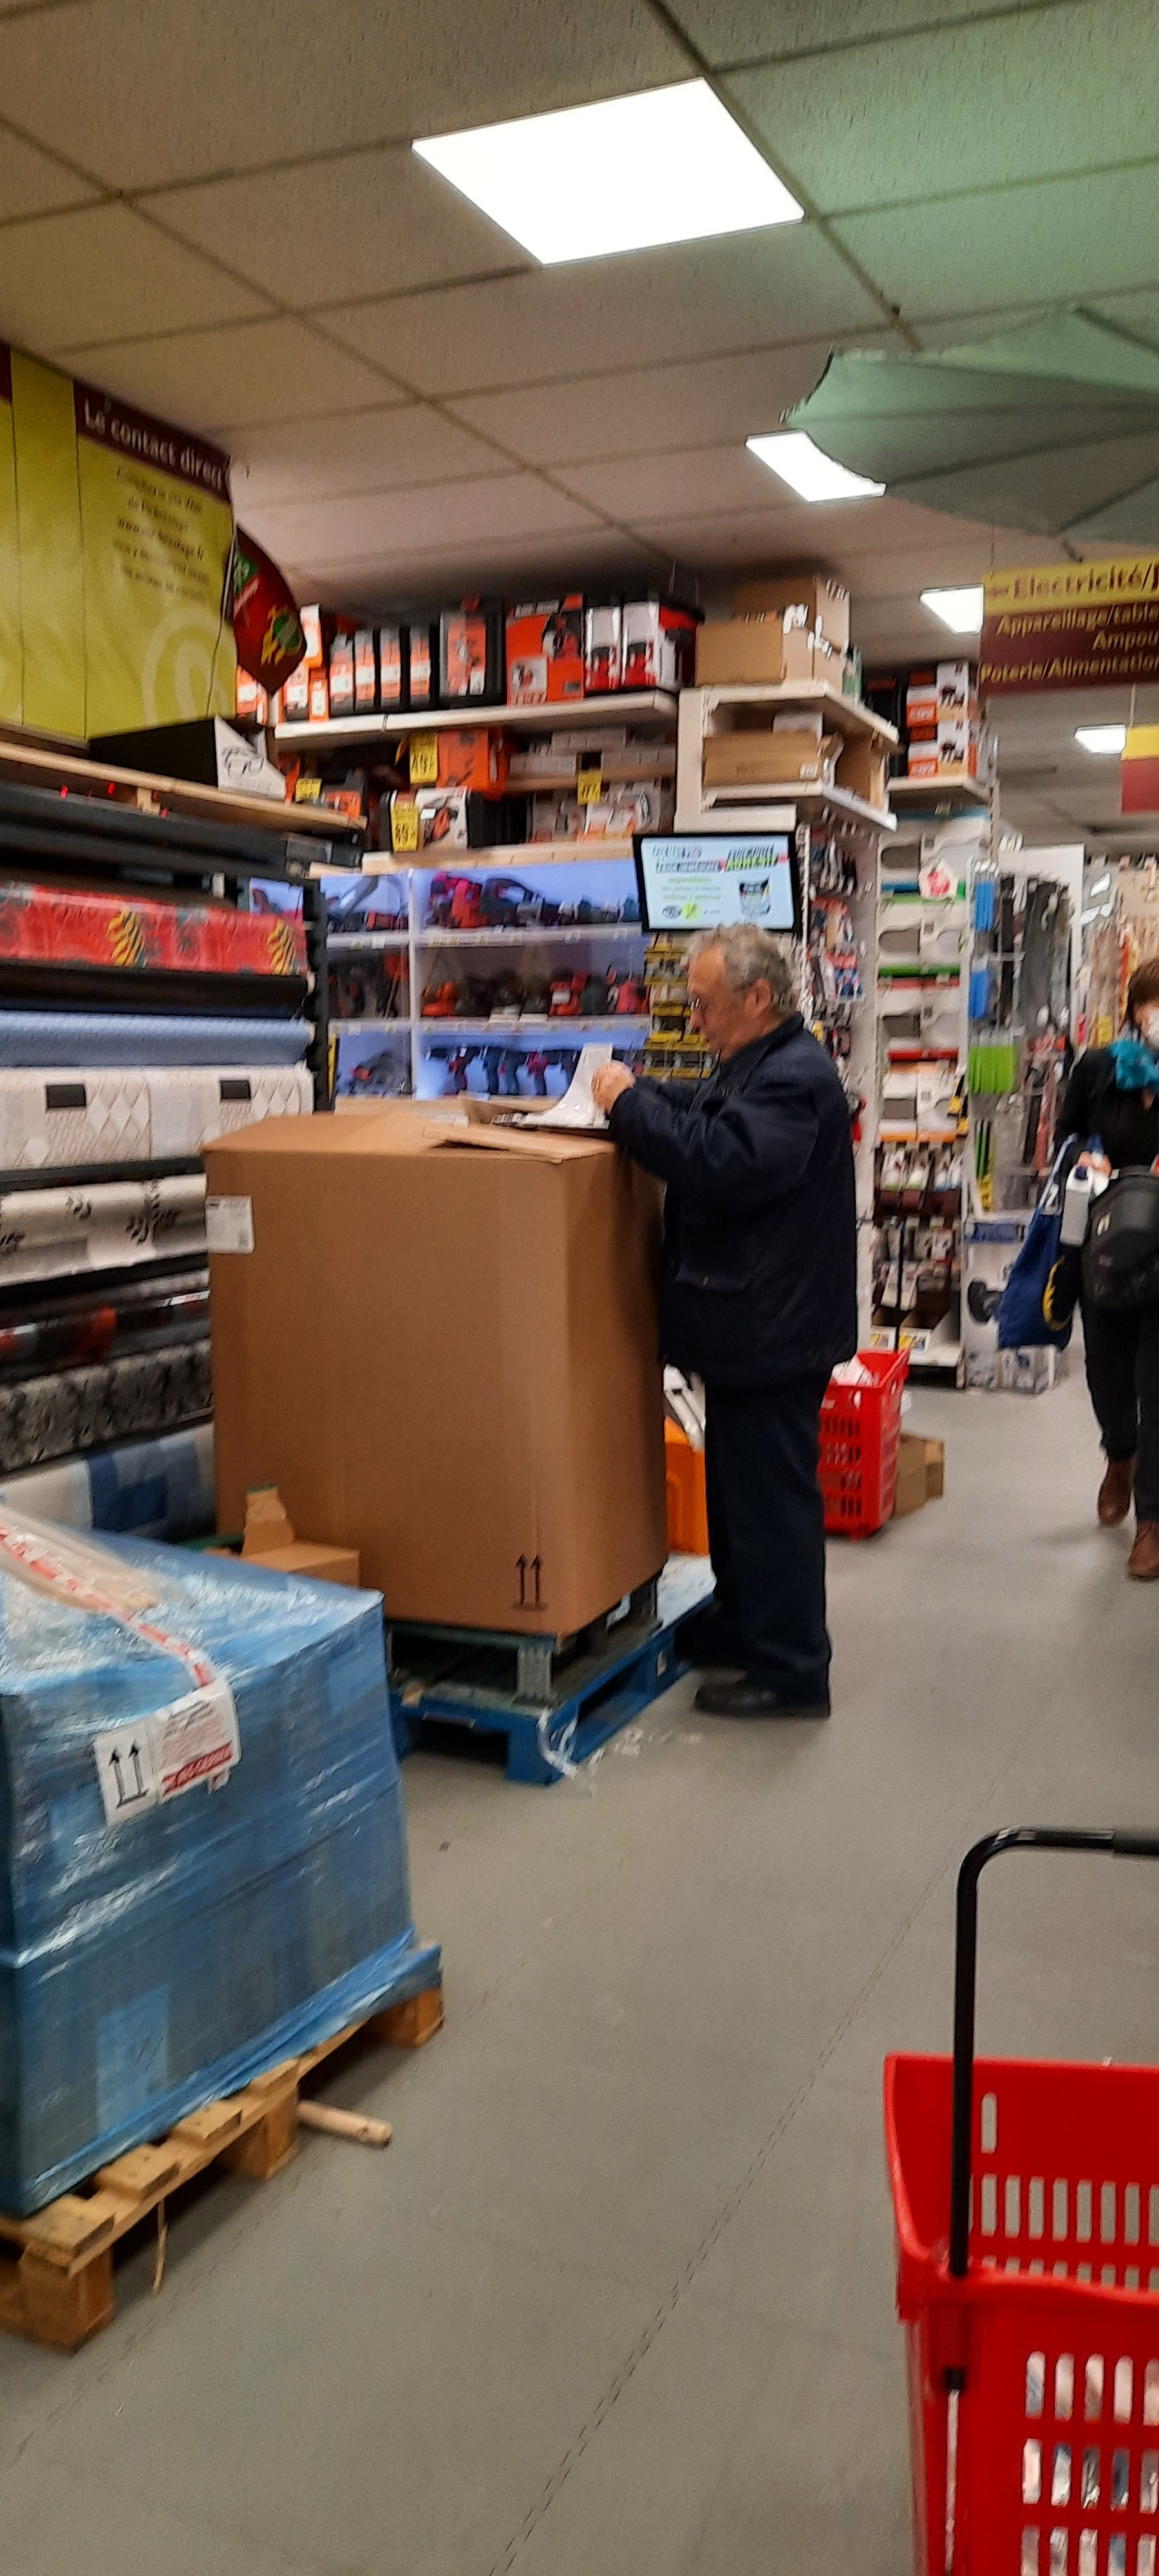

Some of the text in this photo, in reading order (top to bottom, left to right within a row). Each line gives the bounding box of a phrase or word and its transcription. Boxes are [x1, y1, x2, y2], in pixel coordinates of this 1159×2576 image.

[84, 397, 223, 491] Le contact direct
[1091, 630, 1158, 653] Ampou
